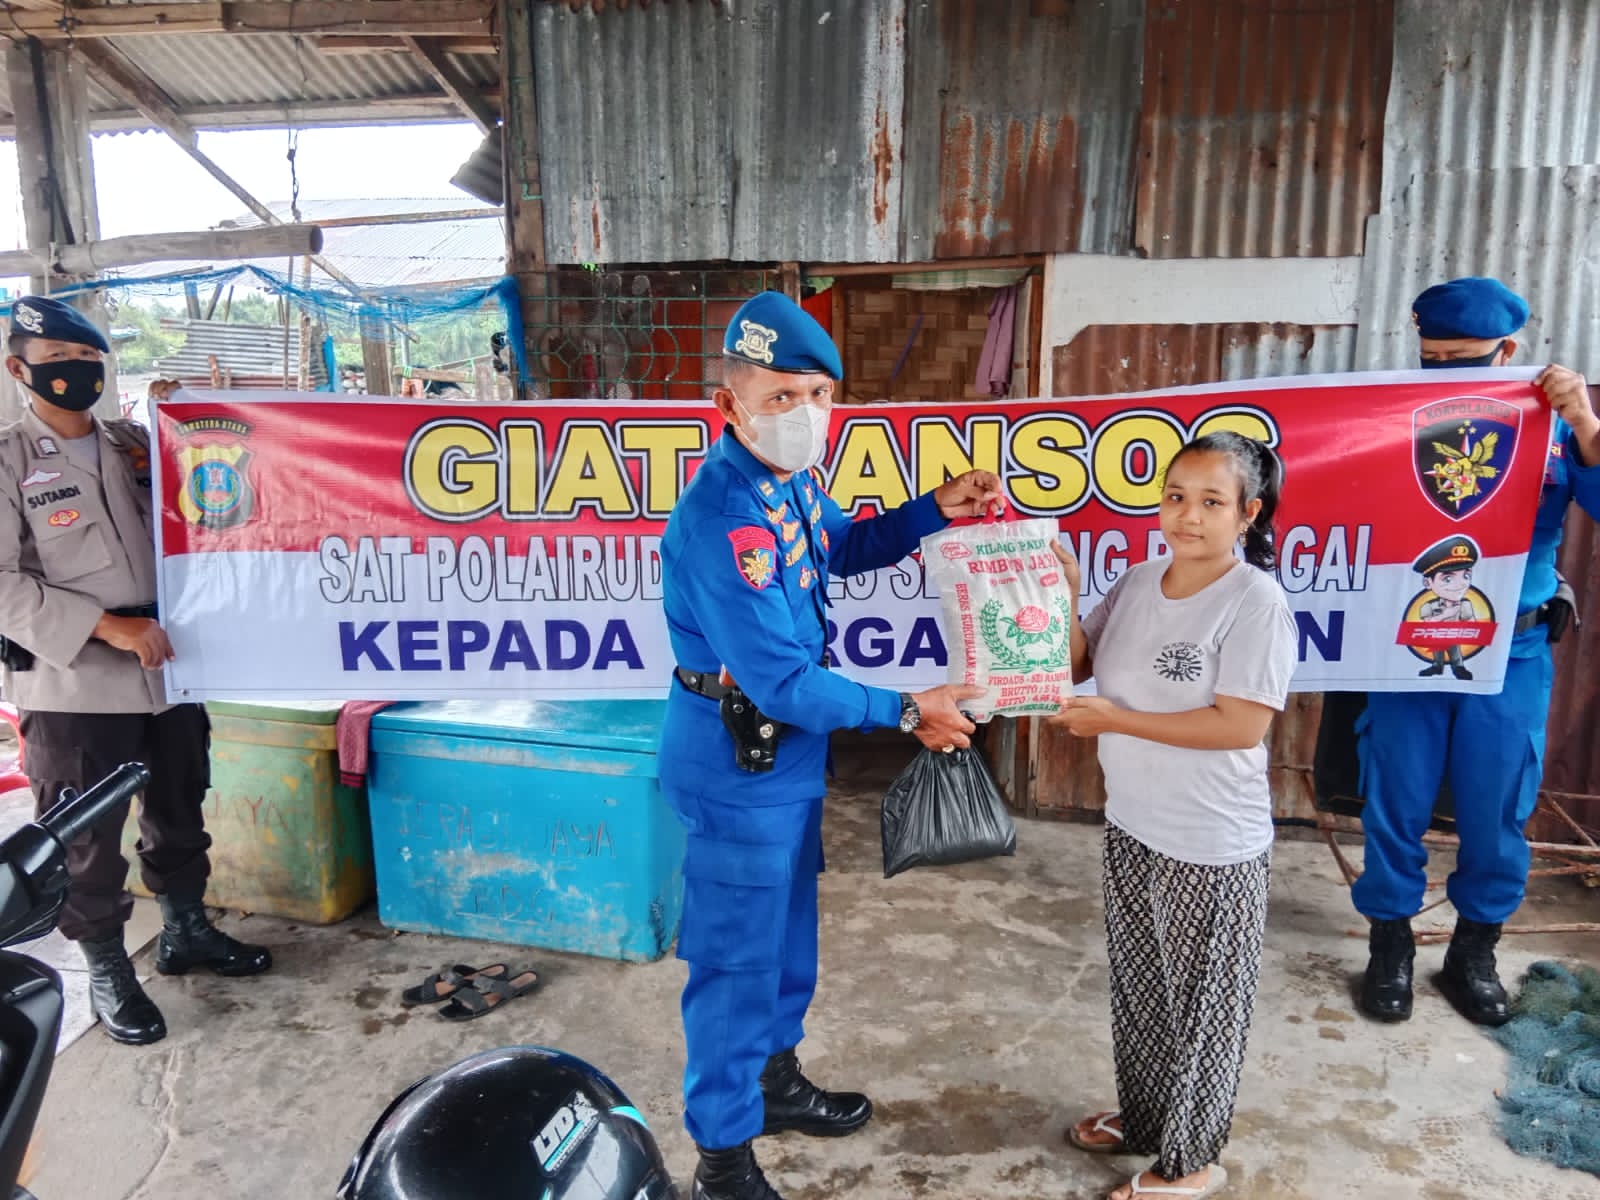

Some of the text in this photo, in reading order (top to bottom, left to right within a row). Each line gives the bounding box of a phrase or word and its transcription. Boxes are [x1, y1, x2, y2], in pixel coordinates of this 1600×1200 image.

[403, 403, 1281, 523] GIAT ANSO
[28, 484, 81, 509] SUTARDI
[319, 535, 412, 603] SAT
[967, 558, 1025, 574] RIMBN
[338, 619, 645, 672] KEPADA
[1411, 627, 1481, 639] PRESISI
